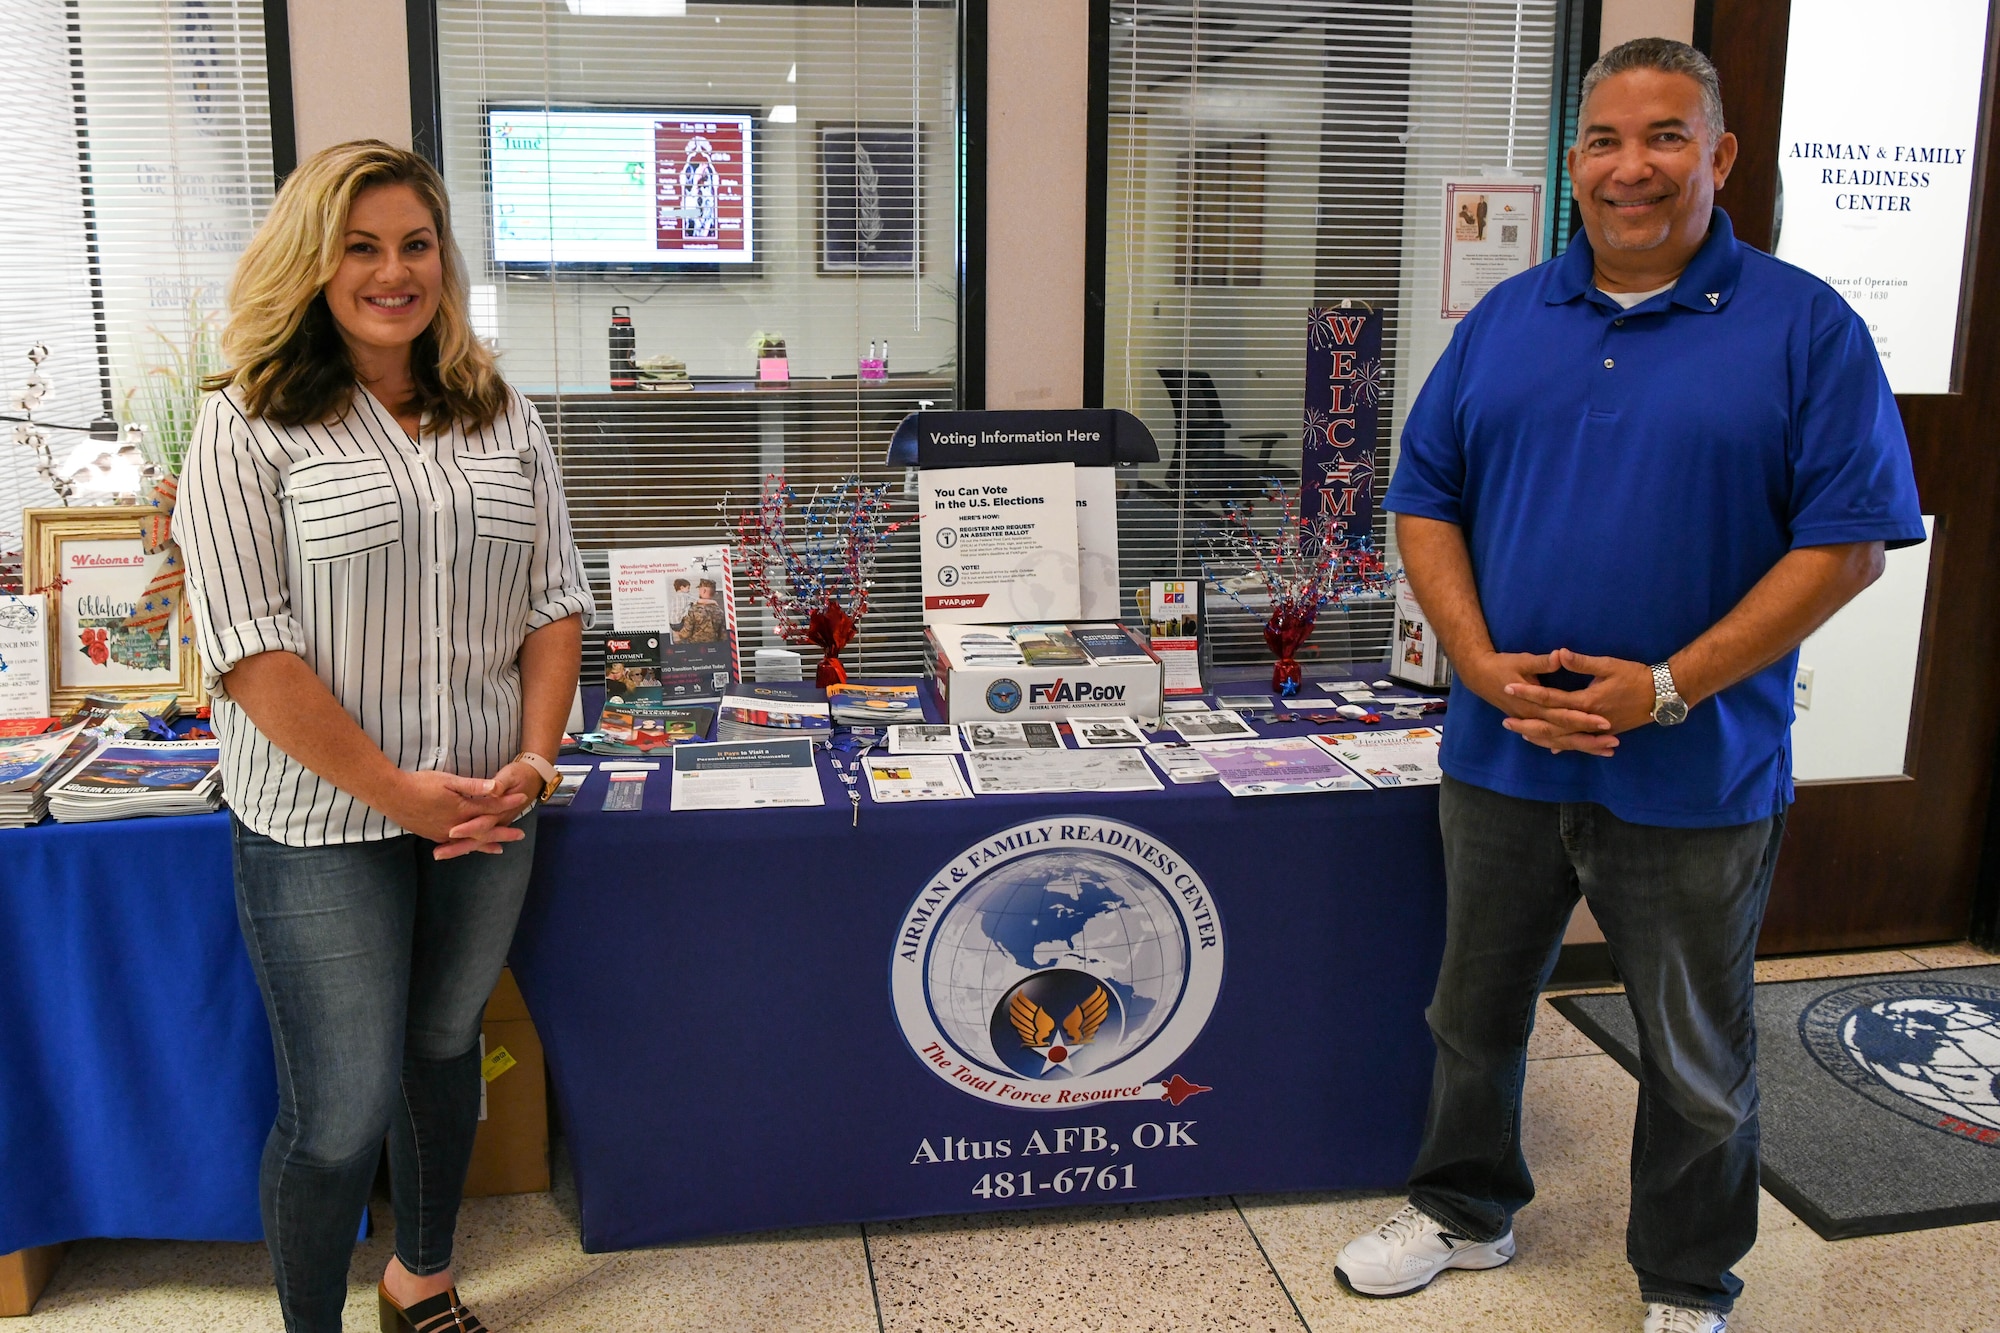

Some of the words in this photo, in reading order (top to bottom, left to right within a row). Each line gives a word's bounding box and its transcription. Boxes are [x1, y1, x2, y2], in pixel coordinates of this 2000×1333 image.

[1789, 142, 1870, 160] AIRMAN
[1876, 146, 1887, 159] &
[1894, 146, 1966, 164] FAMILY
[1821, 168, 1930, 188] READINESS
[1835, 193, 1911, 212] CENTER
[1825, 276, 1850, 285] Hours
[1853, 277, 1862, 285] of
[1865, 278, 1908, 288] Operation
[1842, 290, 1862, 300] 0730
[1870, 291, 1888, 300] 1630
[930, 432, 976, 447] Voting
[981, 430, 1062, 444] Information
[1066, 429, 1100, 442] Here
[935, 489, 955, 498] You
[958, 488, 979, 496] Can
[982, 486, 1008, 495] Vote
[935, 501, 945, 510] in
[948, 500, 966, 509] the
[969, 498, 990, 508] U.S.
[994, 496, 1044, 506] Elections
[944, 536, 950, 545] 1
[72, 554, 130, 566] Welcome
[133, 555, 144, 564] to
[945, 574, 952, 582] 2
[938, 598, 975, 607] FVAP.gov
[1030, 678, 1126, 702] FVAP.GOV
[62, 784, 102, 794] MODERN
[900, 881, 951, 962] AIRMAN
[950, 867, 968, 883] &
[966, 826, 1053, 869] FAMILY
[1060, 825, 1178, 876] READINESS
[1174, 874, 1216, 950] CENTER
[922, 1041, 952, 1068] The
[951, 1064, 997, 1093] Total
[996, 1084, 1052, 1104] Force
[1056, 1085, 1142, 1104] Resource
[910, 1136, 1012, 1165] Altus
[1021, 1126, 1120, 1158] AFB,
[1132, 1120, 1199, 1149] OK
[971, 1163, 1138, 1199] 481-6761
